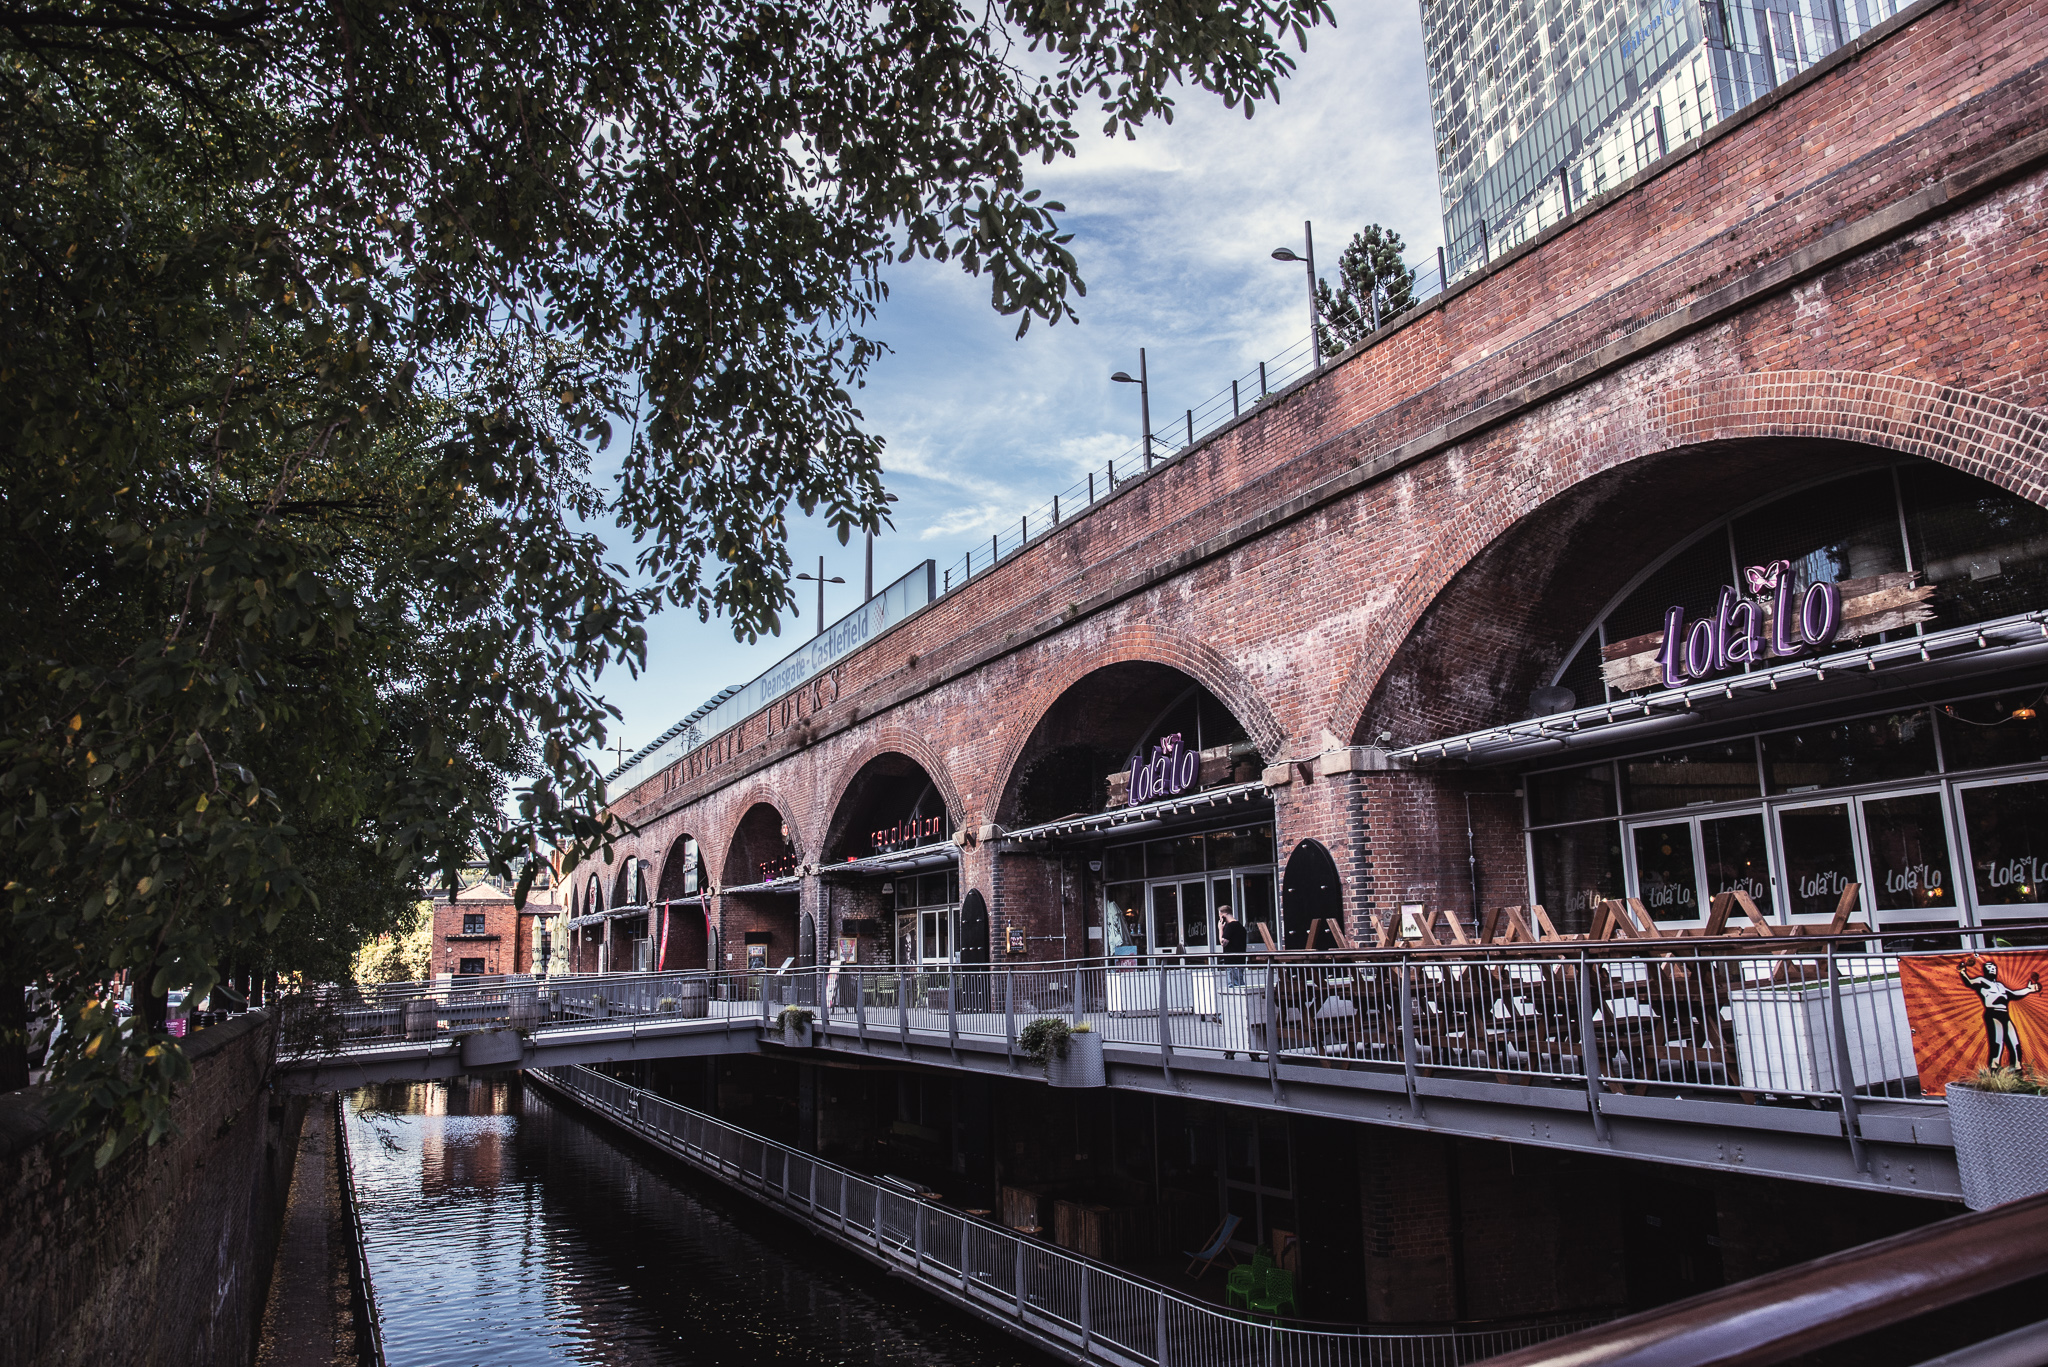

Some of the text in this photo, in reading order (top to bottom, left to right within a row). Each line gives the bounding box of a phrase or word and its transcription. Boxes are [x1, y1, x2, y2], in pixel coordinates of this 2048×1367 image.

[1622, 15, 1662, 59] Hilton
[663, 668, 840, 793] DEANSGATE LOCKS
[871, 815, 942, 848] revolution
[1799, 873, 1829, 899] Lola
[1885, 865, 1942, 893] Lola Lo
[1649, 883, 1690, 908] Lola Lo
